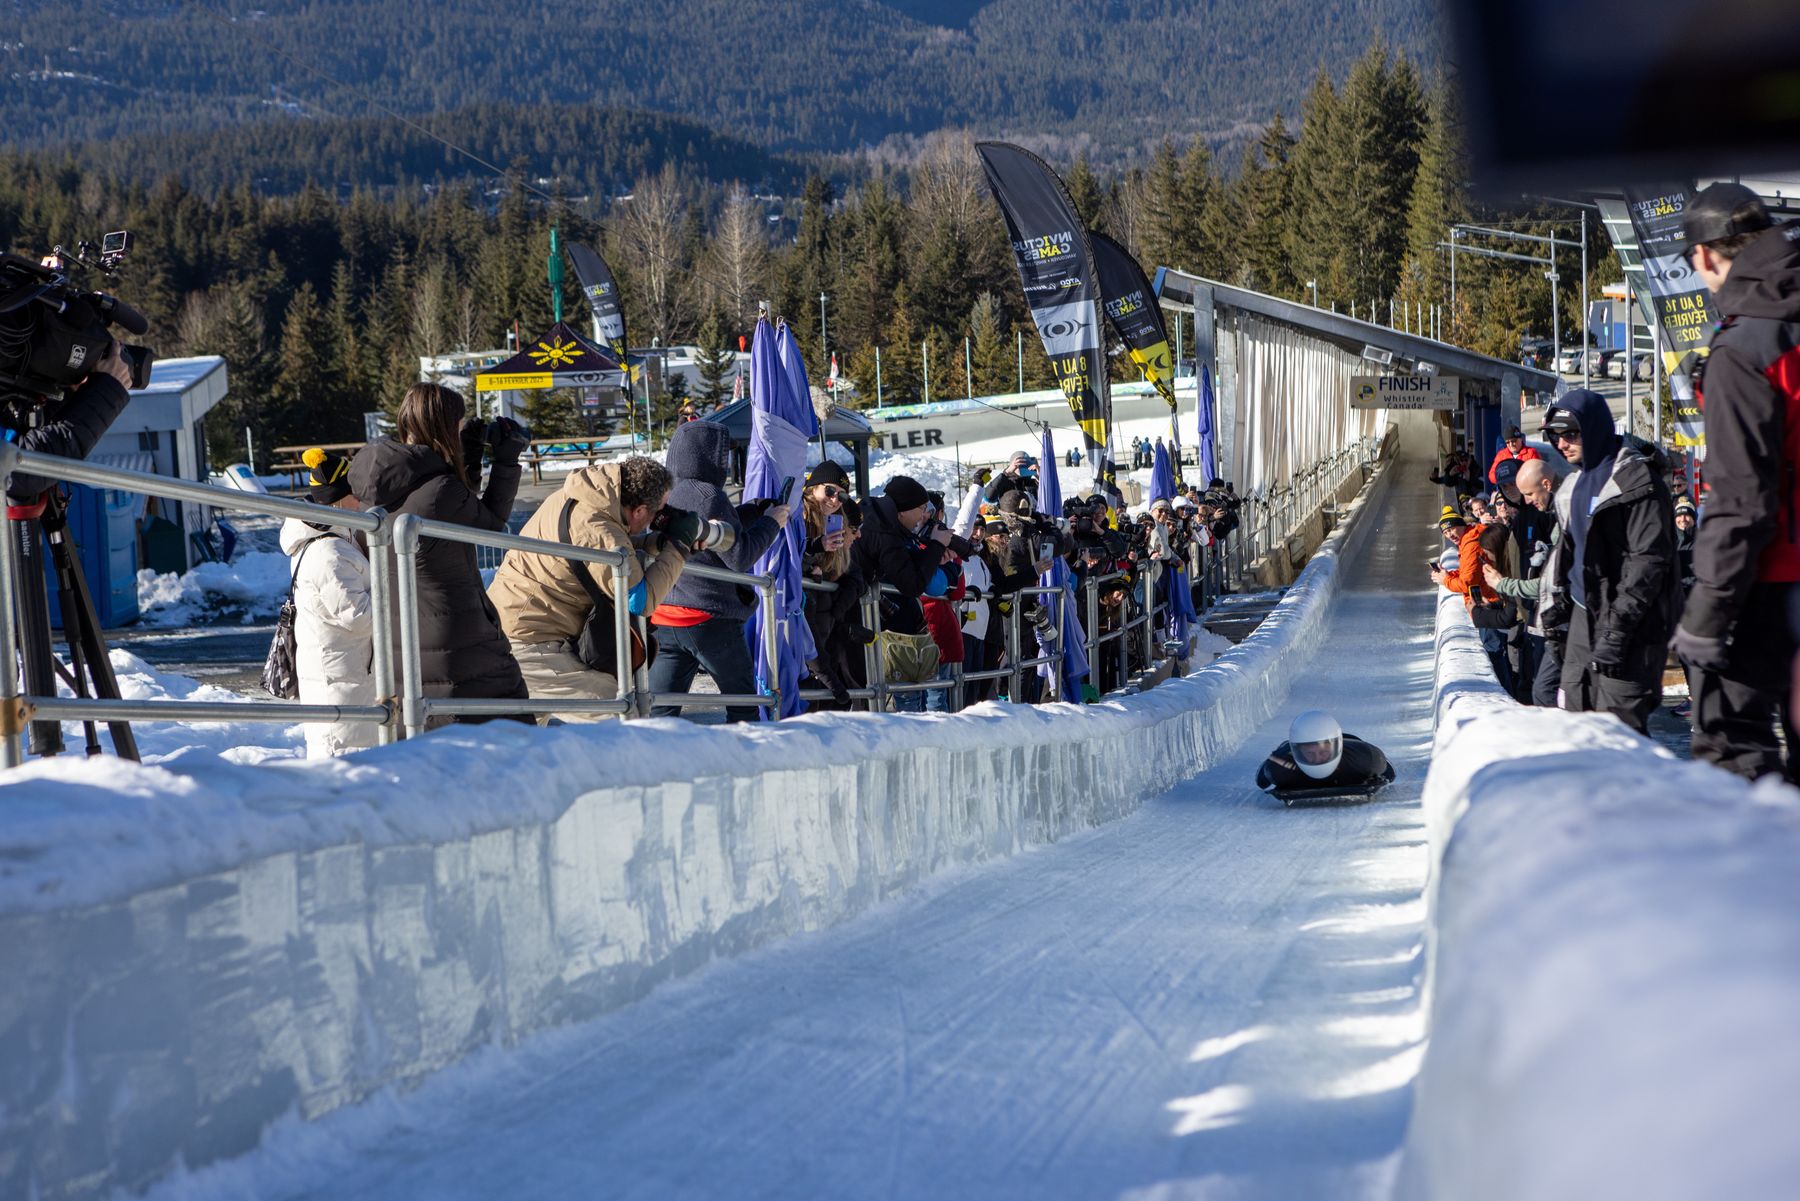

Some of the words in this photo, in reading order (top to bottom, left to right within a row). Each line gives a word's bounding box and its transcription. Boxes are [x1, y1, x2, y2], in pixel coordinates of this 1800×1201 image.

[1379, 377, 1431, 391] FINISH
[1383, 394, 1425, 402] Whistler
[21, 520, 31, 557] sachtler
